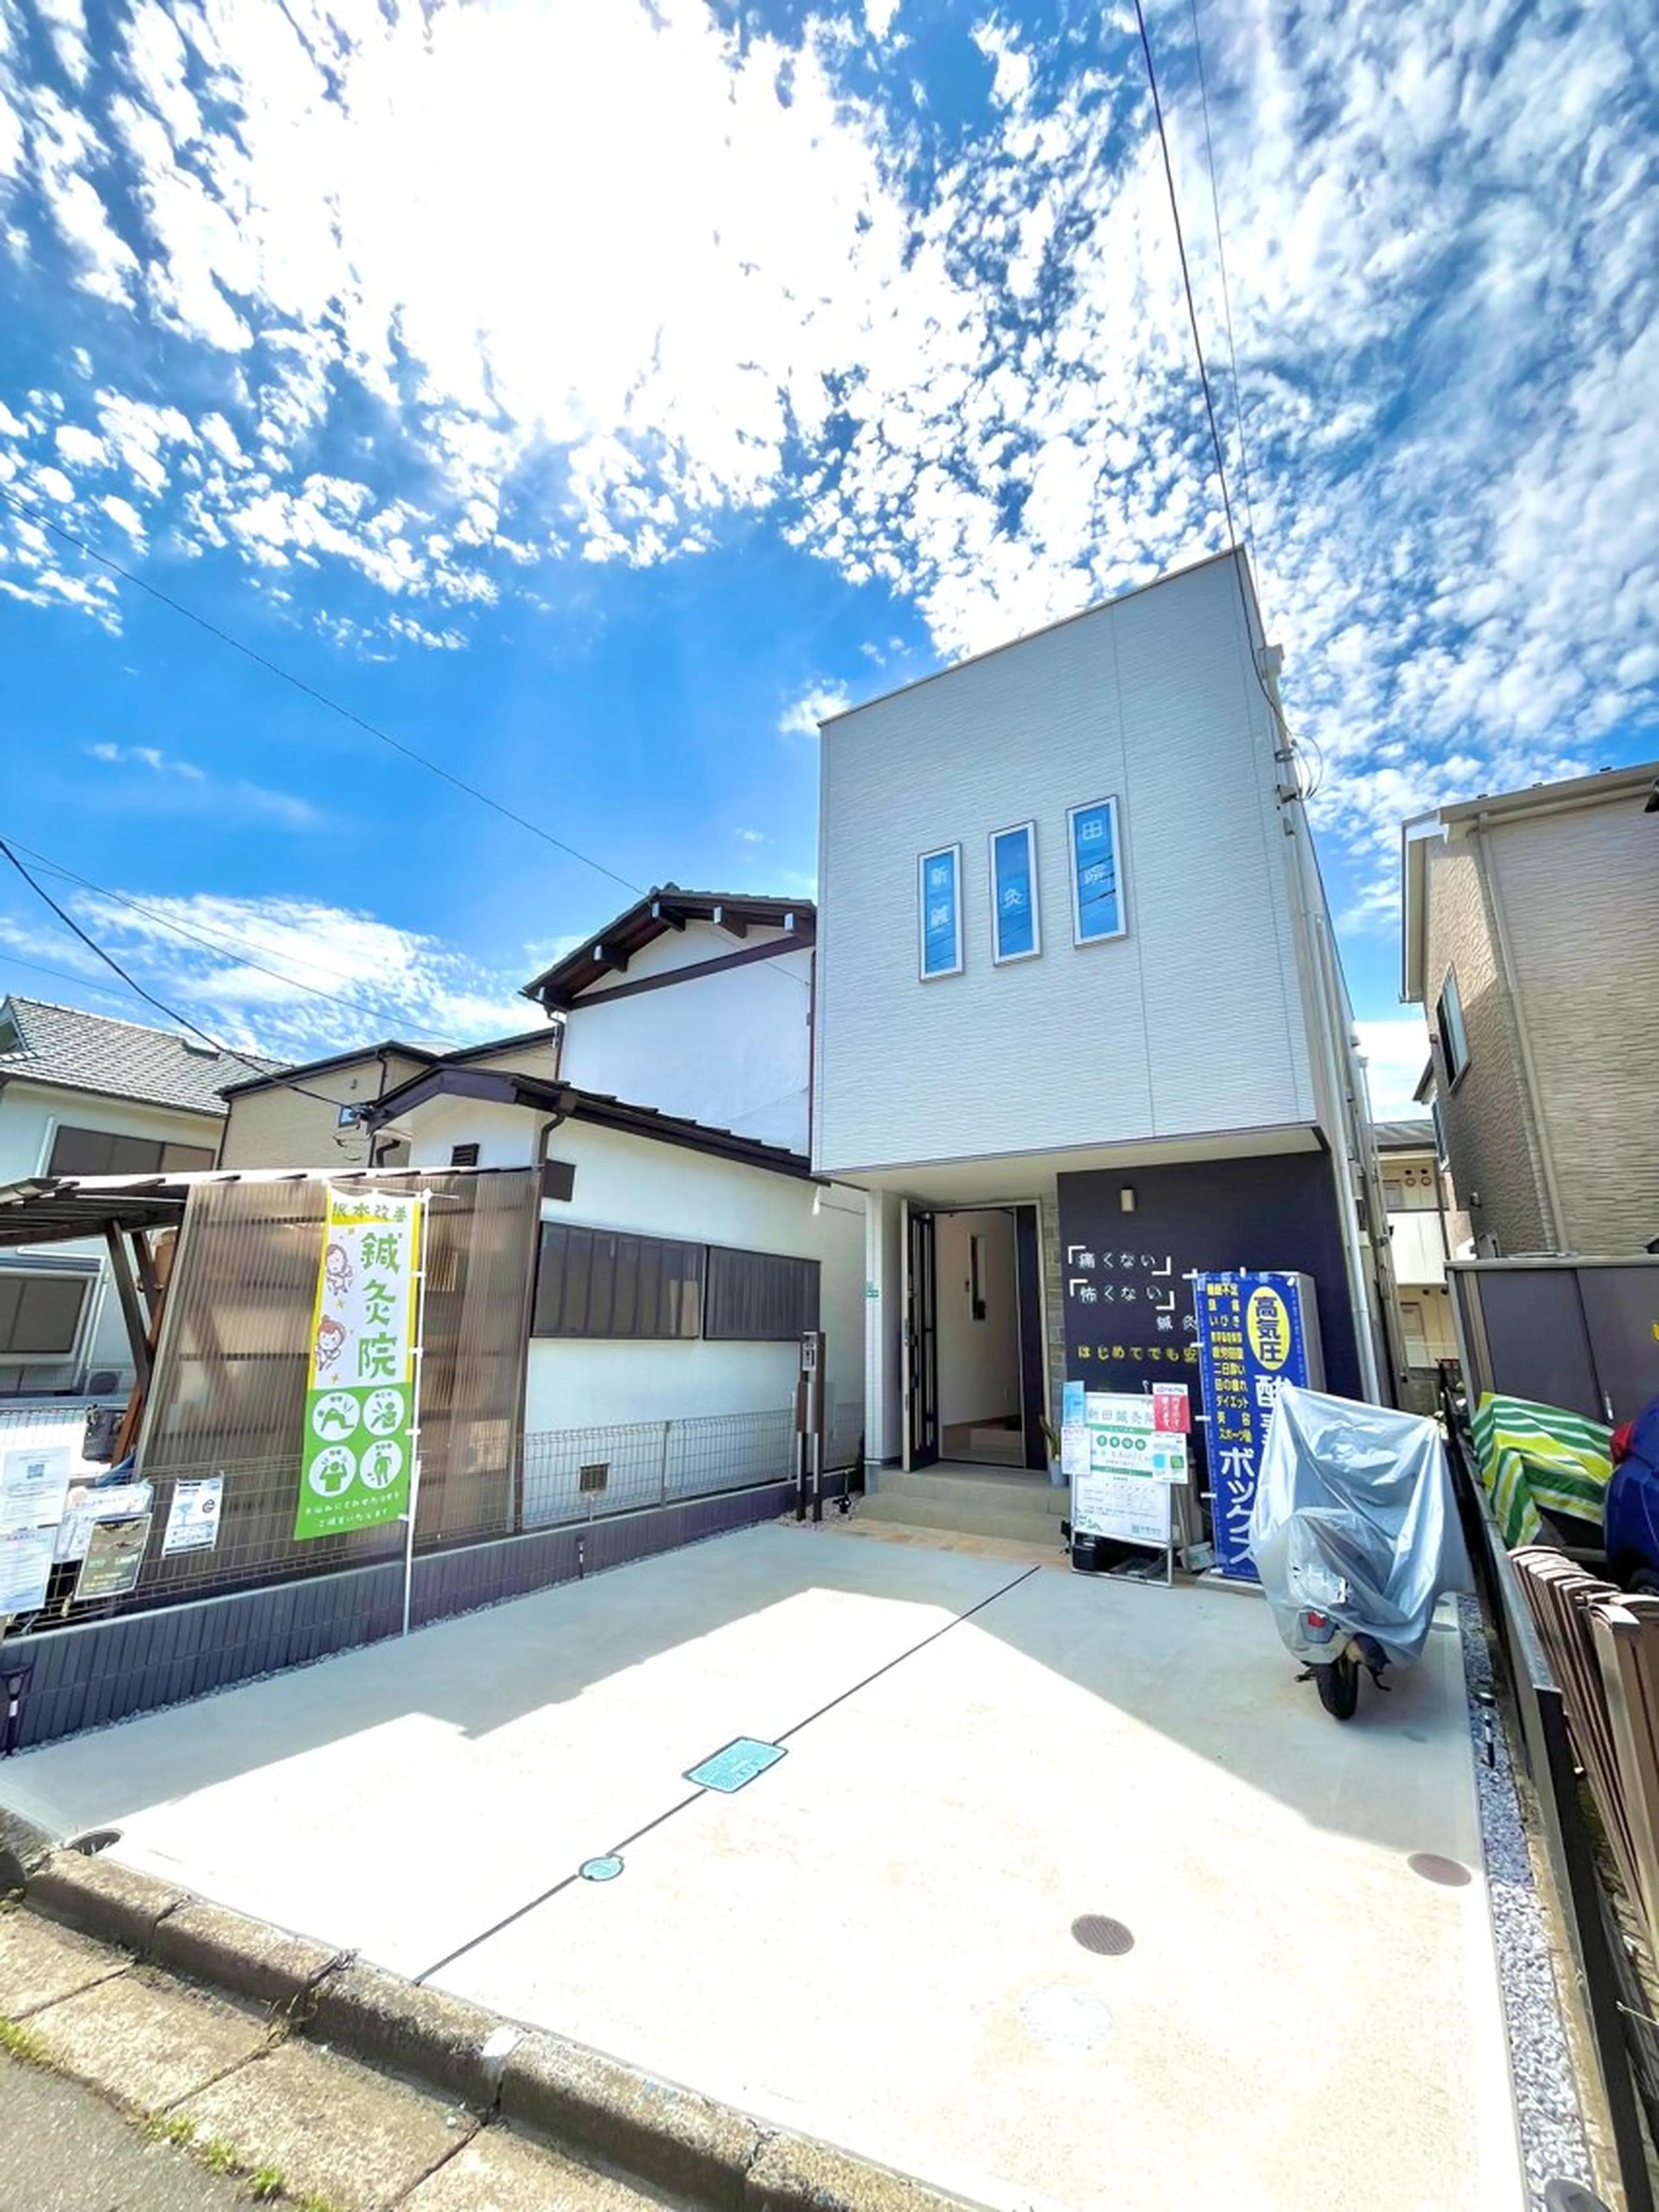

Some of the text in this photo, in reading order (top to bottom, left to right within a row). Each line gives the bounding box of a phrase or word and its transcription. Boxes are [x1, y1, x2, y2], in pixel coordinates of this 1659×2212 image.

[357, 1232, 403, 1380] 鍼灸院
[1254, 1296, 1283, 1362] 高気圧
[1077, 1346, 1198, 1363] はじめてでも安
[1213, 1362, 1246, 1375] 二日酔い
